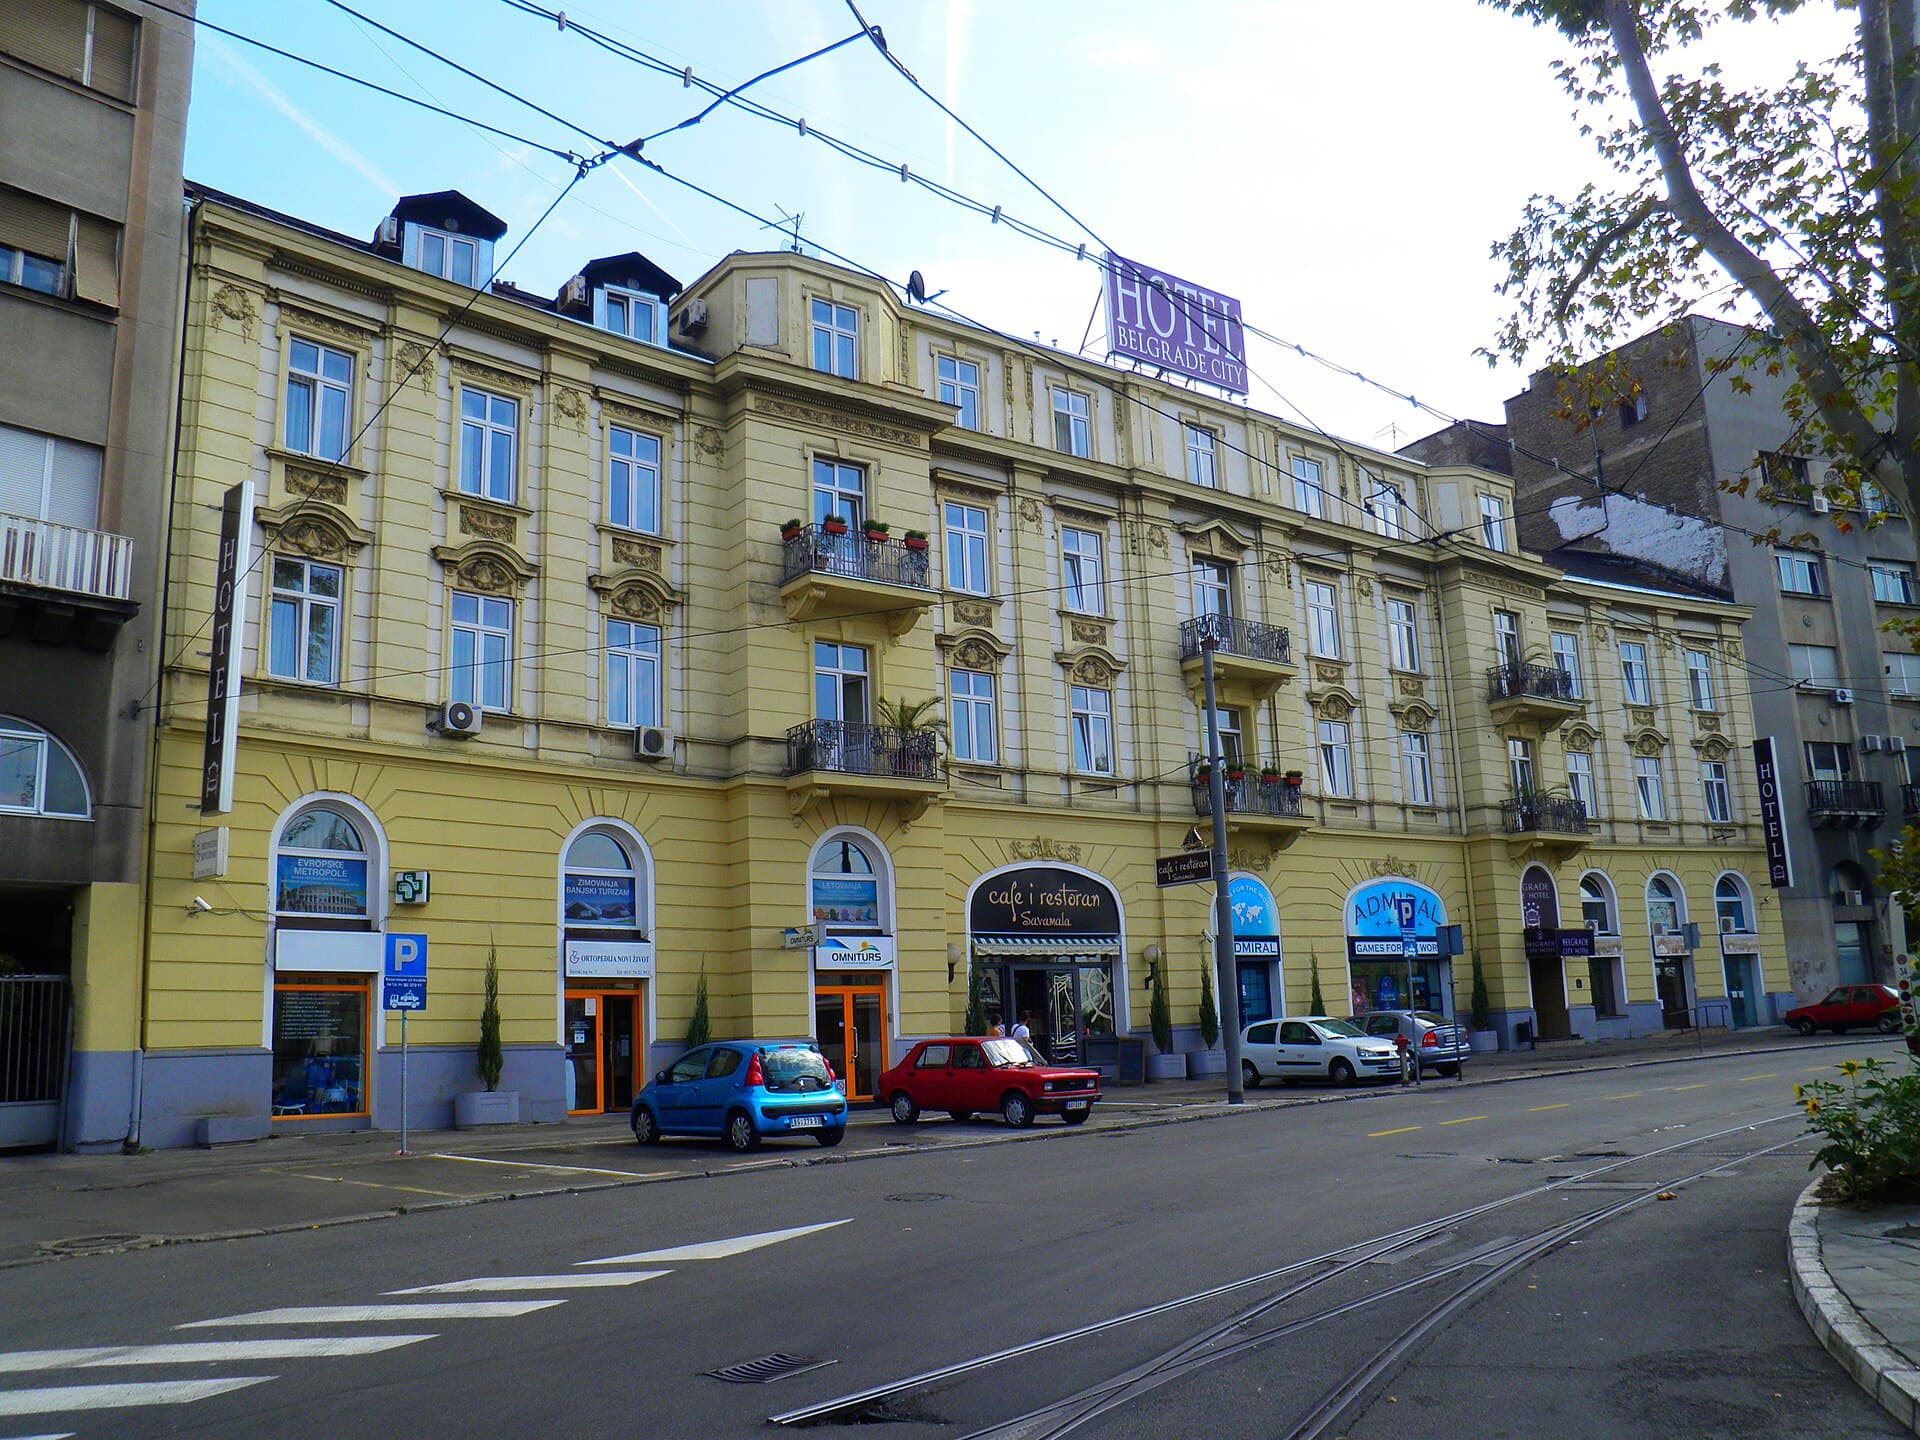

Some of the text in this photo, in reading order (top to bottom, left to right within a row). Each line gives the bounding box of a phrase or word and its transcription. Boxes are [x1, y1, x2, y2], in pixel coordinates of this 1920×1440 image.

[1113, 261, 1242, 362] HOTEL
[1117, 326, 1243, 385] BELGRADE CITY
[211, 538, 236, 745] HOTEL
[1759, 763, 1782, 858] HOTEL
[298, 859, 345, 869] EVROPSKE
[1158, 861, 1173, 880] cafe
[1179, 857, 1209, 871] restoran
[294, 868, 348, 878] METROPOLE
[577, 879, 619, 888] ZIMOVANJA
[822, 882, 862, 890] LETOVANJA
[1246, 885, 1258, 894] THE
[598, 888, 630, 896] TURIZAM
[988, 881, 1100, 922] cafe i restoran
[1354, 891, 1442, 926] ADMAL
[1020, 911, 1072, 927] Savamala
[1401, 902, 1412, 925] P
[394, 938, 418, 971] P
[1234, 942, 1277, 953] DMIRAL
[1356, 943, 1385, 953] GAMES
[1386, 943, 1402, 953] FOR
[831, 952, 882, 962] OMNITURS
